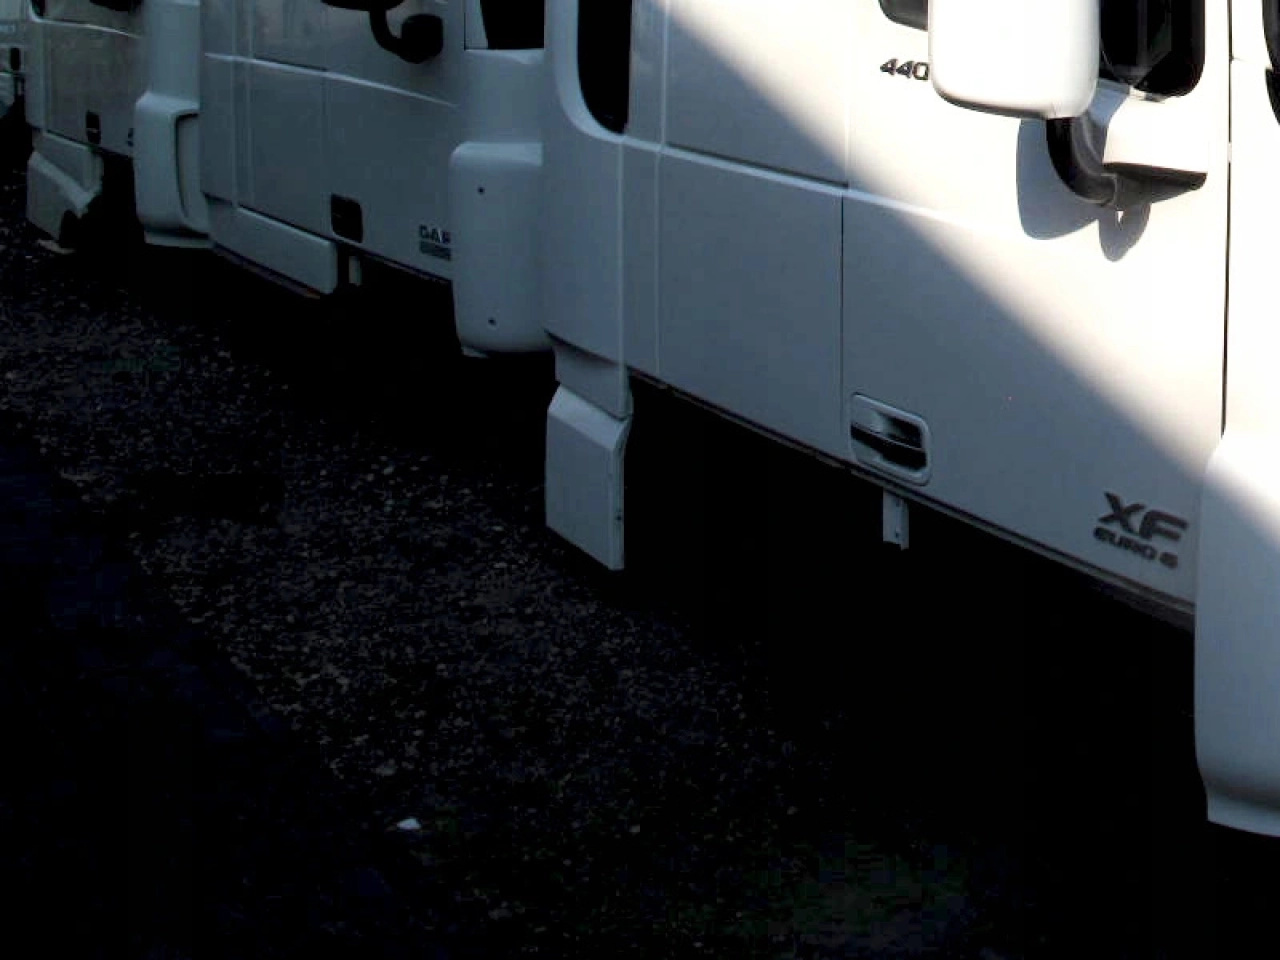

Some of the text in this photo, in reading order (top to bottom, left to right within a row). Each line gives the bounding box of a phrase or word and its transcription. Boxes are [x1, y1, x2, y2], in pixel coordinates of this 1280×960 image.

[880, 58, 929, 81] 440
[1098, 490, 1188, 540] XF
[1093, 526, 1157, 561] EURO
